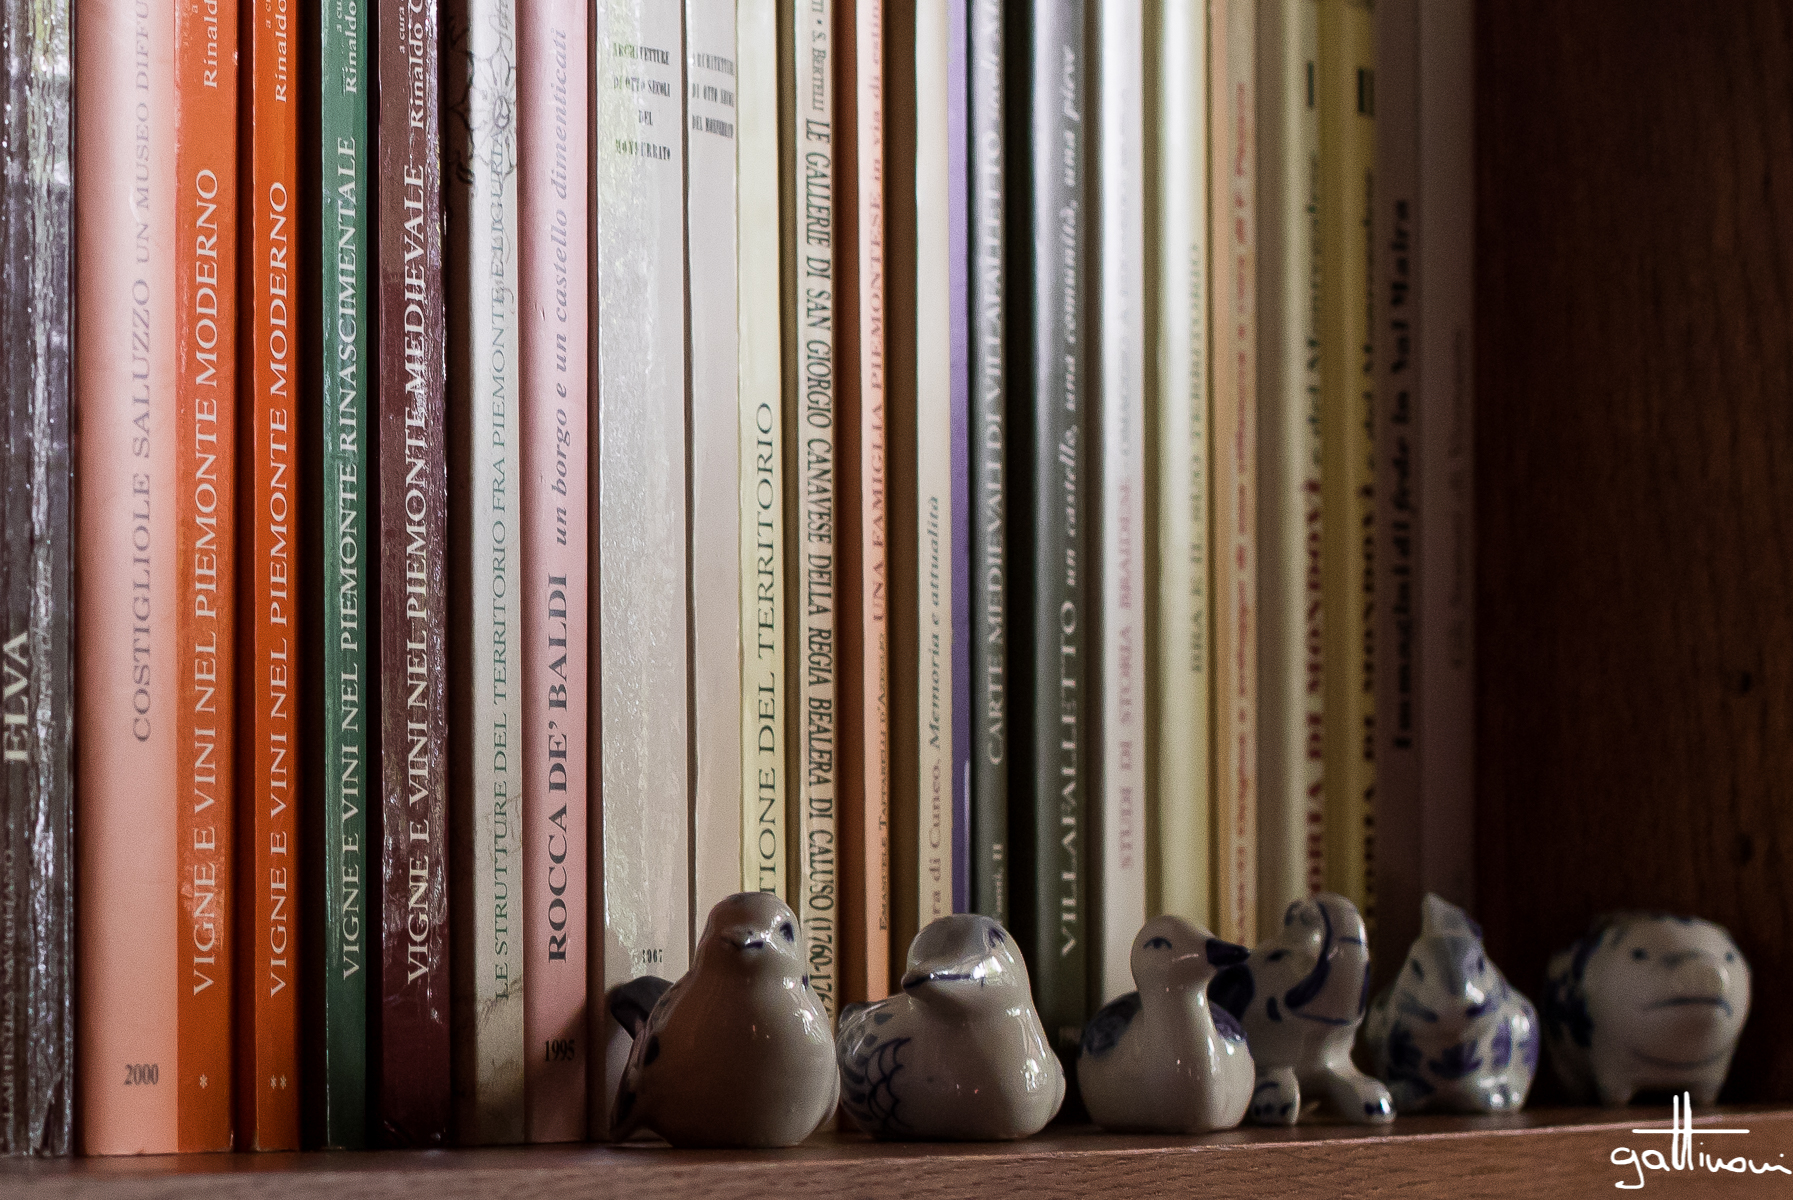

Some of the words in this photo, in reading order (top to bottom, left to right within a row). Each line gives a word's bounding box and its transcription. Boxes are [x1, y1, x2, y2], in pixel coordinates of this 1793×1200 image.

[344, 1, 357, 94] Rinaldo
[408, 22, 424, 131] Rinaldo
[867, 75, 881, 100] di
[135, 102, 150, 209] MUSEO
[547, 27, 567, 201] dimenticati
[638, 110, 654, 126] DEL
[806, 117, 831, 146] LE
[869, 109, 881, 146] via
[1062, 130, 1077, 188] una
[490, 128, 504, 254] LIGURIA
[806, 151, 831, 248] GALLERIE
[136, 223, 150, 264] UN
[194, 168, 218, 390] MODERNO
[402, 164, 426, 399] MEDIEVALE
[490, 260, 505, 279] E
[548, 208, 568, 323] castello
[806, 254, 831, 281] DI
[268, 181, 288, 398] MODERNO
[336, 136, 358, 454] RINASCIMENTALE
[806, 287, 831, 330] SAN
[869, 193, 882, 392] PIEMONTESE
[131, 278, 152, 459] SALUZZO
[490, 286, 507, 448] PIEMONTE
[551, 333, 567, 374] un
[552, 383, 567, 399] e
[806, 339, 832, 429] GIORGIO
[1063, 354, 1077, 412] una
[548, 407, 571, 497] borgo
[870, 401, 883, 550] FAMIGLIA
[983, 411, 1003, 450] DI
[194, 397, 218, 620] PIEMONTE
[268, 407, 288, 627] PIEMONTE
[404, 406, 428, 621] PIEMONTE
[490, 458, 507, 513] FRA
[551, 505, 567, 546] un
[807, 437, 832, 545] CANAVESE
[339, 463, 359, 652] PIEMONTE
[755, 402, 776, 661] TERRITORIO
[924, 494, 940, 607] attualità
[984, 458, 1005, 647] MEDIEVALI
[1064, 548, 1077, 587] un
[131, 474, 152, 742] COSTIGLIOLE
[490, 519, 508, 706] TERRITORIO
[807, 553, 832, 617] DELLA
[872, 559, 884, 622] UNA
[930, 613, 941, 626] e
[193, 631, 218, 716] NEL
[269, 636, 288, 721] NEL
[405, 630, 429, 710] NEL
[544, 573, 568, 712] BALDI
[807, 626, 832, 688] REGIA
[1117, 625, 1132, 726] STORIA
[3, 629, 29, 765] ELVA
[340, 663, 360, 733] NEL
[757, 671, 776, 756] DEL
[926, 632, 942, 751] Memoria
[986, 655, 1006, 765] CARTE
[192, 721, 217, 816] VINI
[269, 731, 288, 821] VINI
[341, 744, 361, 824] VINI
[406, 720, 429, 809] VINI
[491, 713, 508, 774] DEL
[808, 695, 833, 787] BEALERA
[1058, 599, 1079, 959] VILLAFALLETTO
[1118, 740, 1132, 772] DI
[192, 824, 217, 852] E
[269, 829, 288, 857] E
[341, 831, 361, 854] E
[406, 820, 430, 844] E
[809, 797, 833, 820] DI
[1118, 785, 1133, 870] STUDI
[492, 780, 509, 957] STRUTTURE
[546, 801, 569, 964] ROCCA
[809, 828, 834, 911] CALUSO
[929, 857, 942, 883] di
[191, 860, 217, 996] VIGNE
[269, 867, 288, 998] VIGNE
[341, 862, 361, 981] VIGNE
[406, 856, 430, 985] VIGNE
[492, 964, 509, 1001] LE
[124, 1064, 159, 1086] 2000
[545, 1039, 575, 1062] 1995
